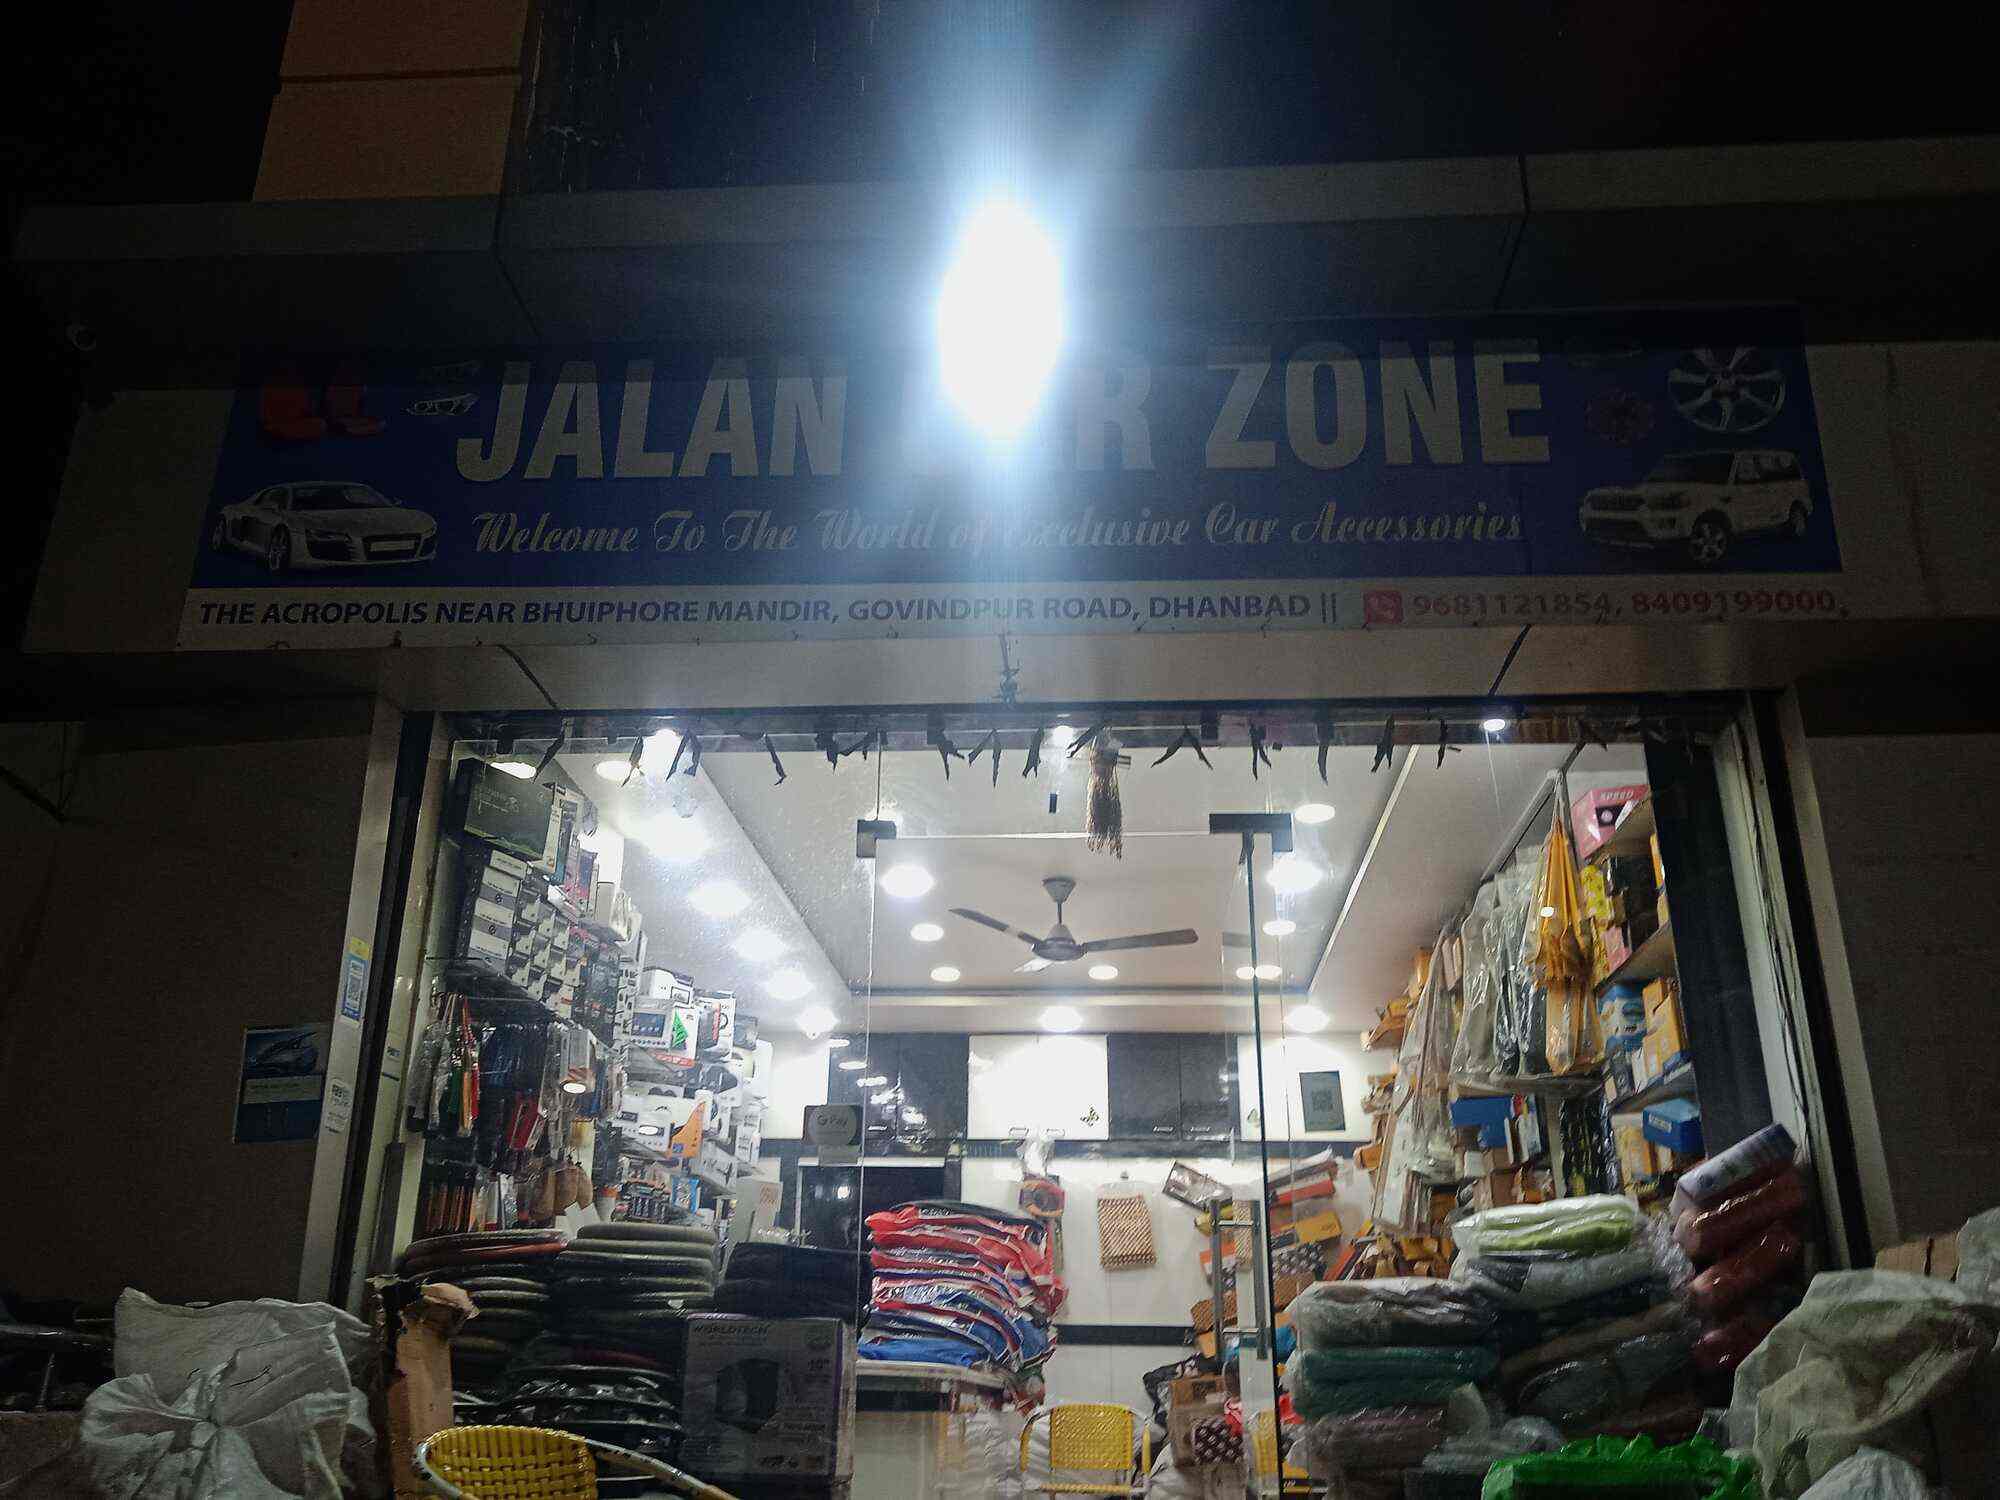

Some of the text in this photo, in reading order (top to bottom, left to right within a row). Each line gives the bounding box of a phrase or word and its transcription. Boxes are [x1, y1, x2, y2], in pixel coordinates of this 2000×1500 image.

[456, 356, 848, 481] JALAN
[1205, 338, 1552, 470] ZONE
[472, 512, 641, 553] Welcome
[653, 510, 706, 552] To
[722, 510, 799, 551] The
[815, 508, 939, 550] World
[949, 509, 989, 557] of
[1205, 503, 1279, 545] Car
[1291, 501, 1523, 543] Accessories
[200, 602, 254, 624] THE
[261, 602, 428, 624] ACROPOLIS
[436, 601, 516, 624] NEAR
[523, 601, 699, 624] BHUIPHORE
[707, 599, 840, 623] MANDIR,
[849, 598, 1034, 621] GOVINDPUR
[1044, 597, 1142, 621] ROAD,
[1149, 595, 1311, 619] DHANBAD
